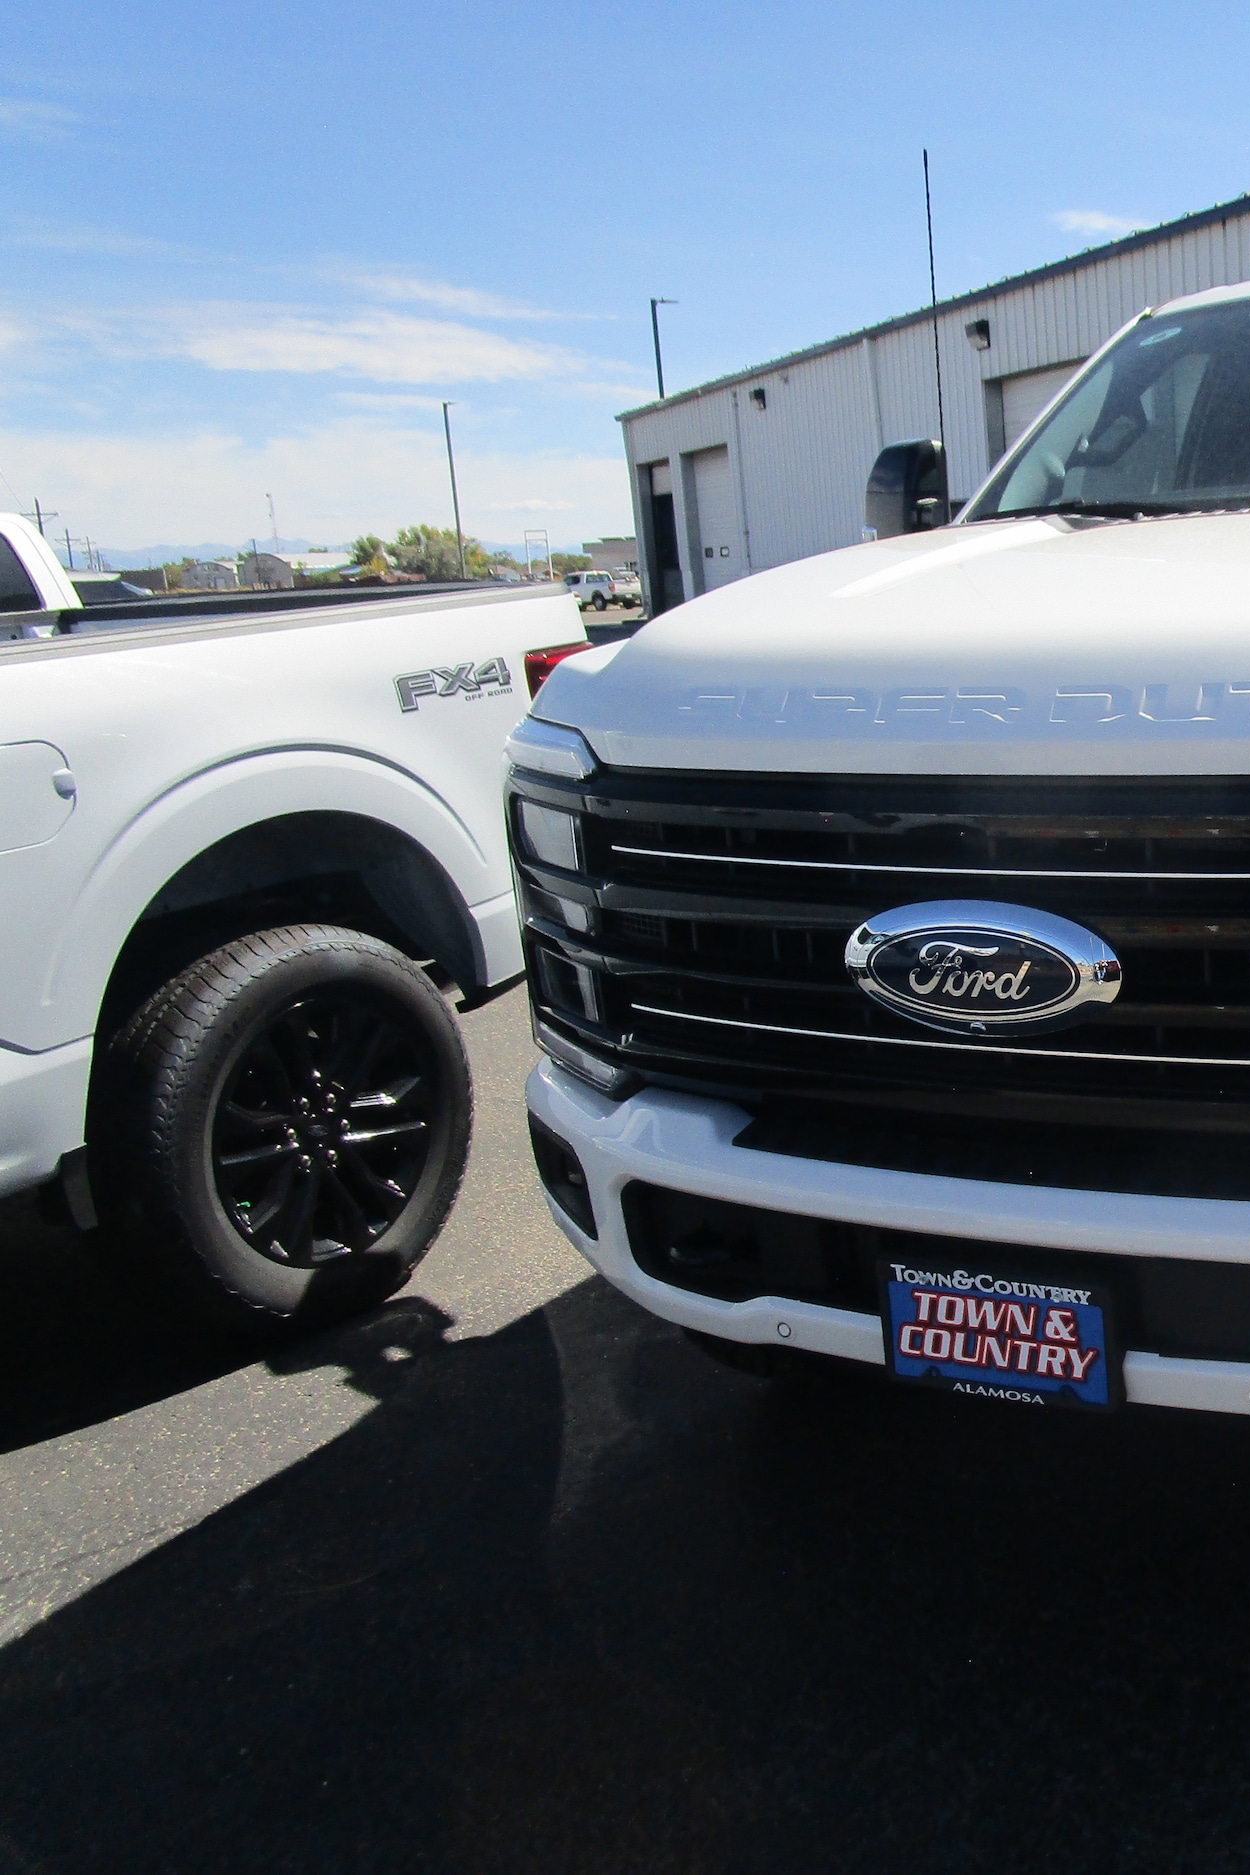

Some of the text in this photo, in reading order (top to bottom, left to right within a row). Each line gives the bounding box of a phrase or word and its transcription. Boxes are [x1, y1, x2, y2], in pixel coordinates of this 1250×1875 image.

[393, 656, 511, 713] FX4
[464, 687, 513, 702] OFF ROAD
[908, 941, 1032, 1001] Ford
[914, 1291, 1077, 1342] TOWN &
[900, 1325, 1097, 1379] COUNTRY
[953, 1382, 1045, 1406] ALAMOSA
